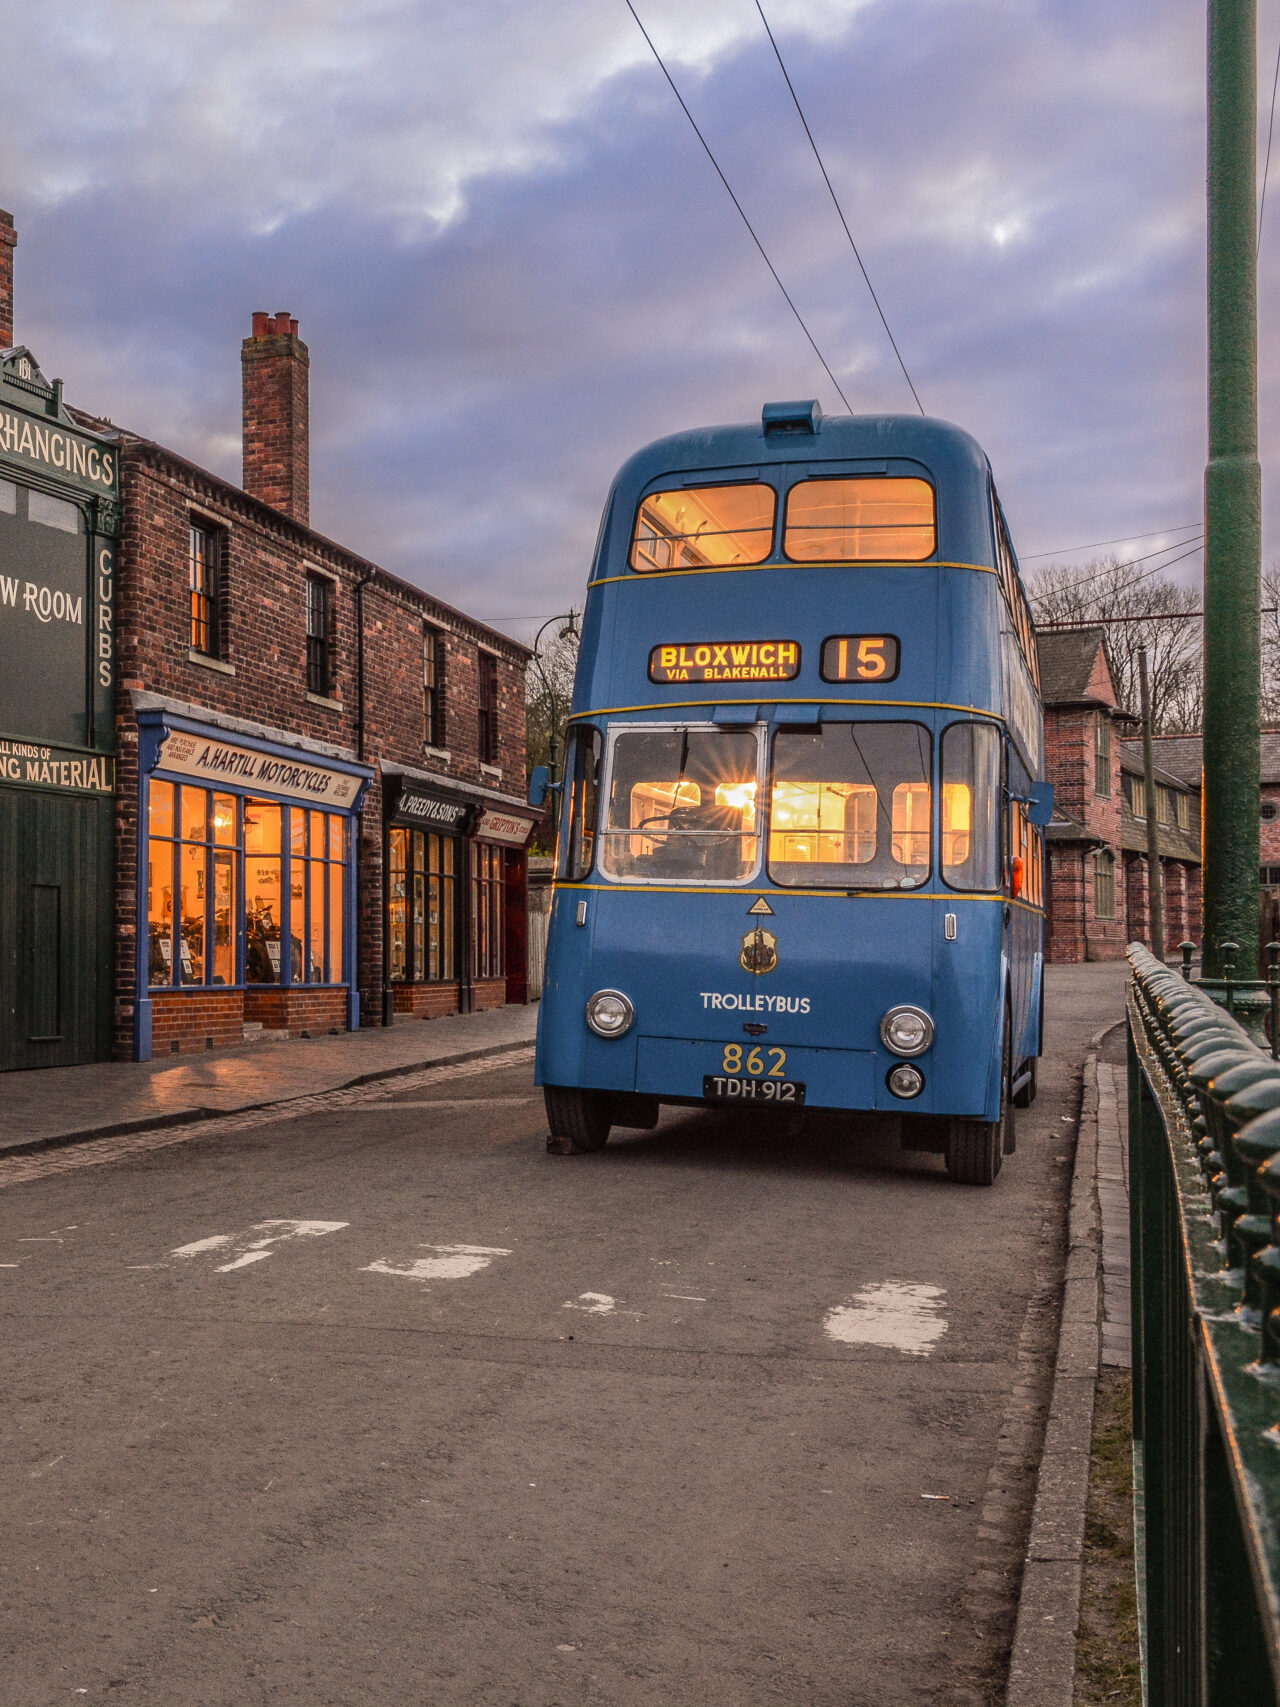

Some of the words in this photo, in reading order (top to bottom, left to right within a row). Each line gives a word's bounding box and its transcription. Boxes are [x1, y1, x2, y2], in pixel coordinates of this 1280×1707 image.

[23, 581, 83, 625] ROOM
[99, 549, 113, 687] CURBS
[660, 643, 795, 668] BLOXWICH
[838, 639, 886, 679] 15
[666, 669, 689, 680] VIA
[704, 666, 787, 680] BLAKENALL
[12, 743, 39, 759] KINDS
[40, 746, 51, 760] OF
[26, 756, 112, 792] MATERIAL
[256, 759, 332, 794] MOTORCYCLES
[700, 992, 811, 1014] TROLLEYBUS
[722, 1043, 787, 1077] 862
